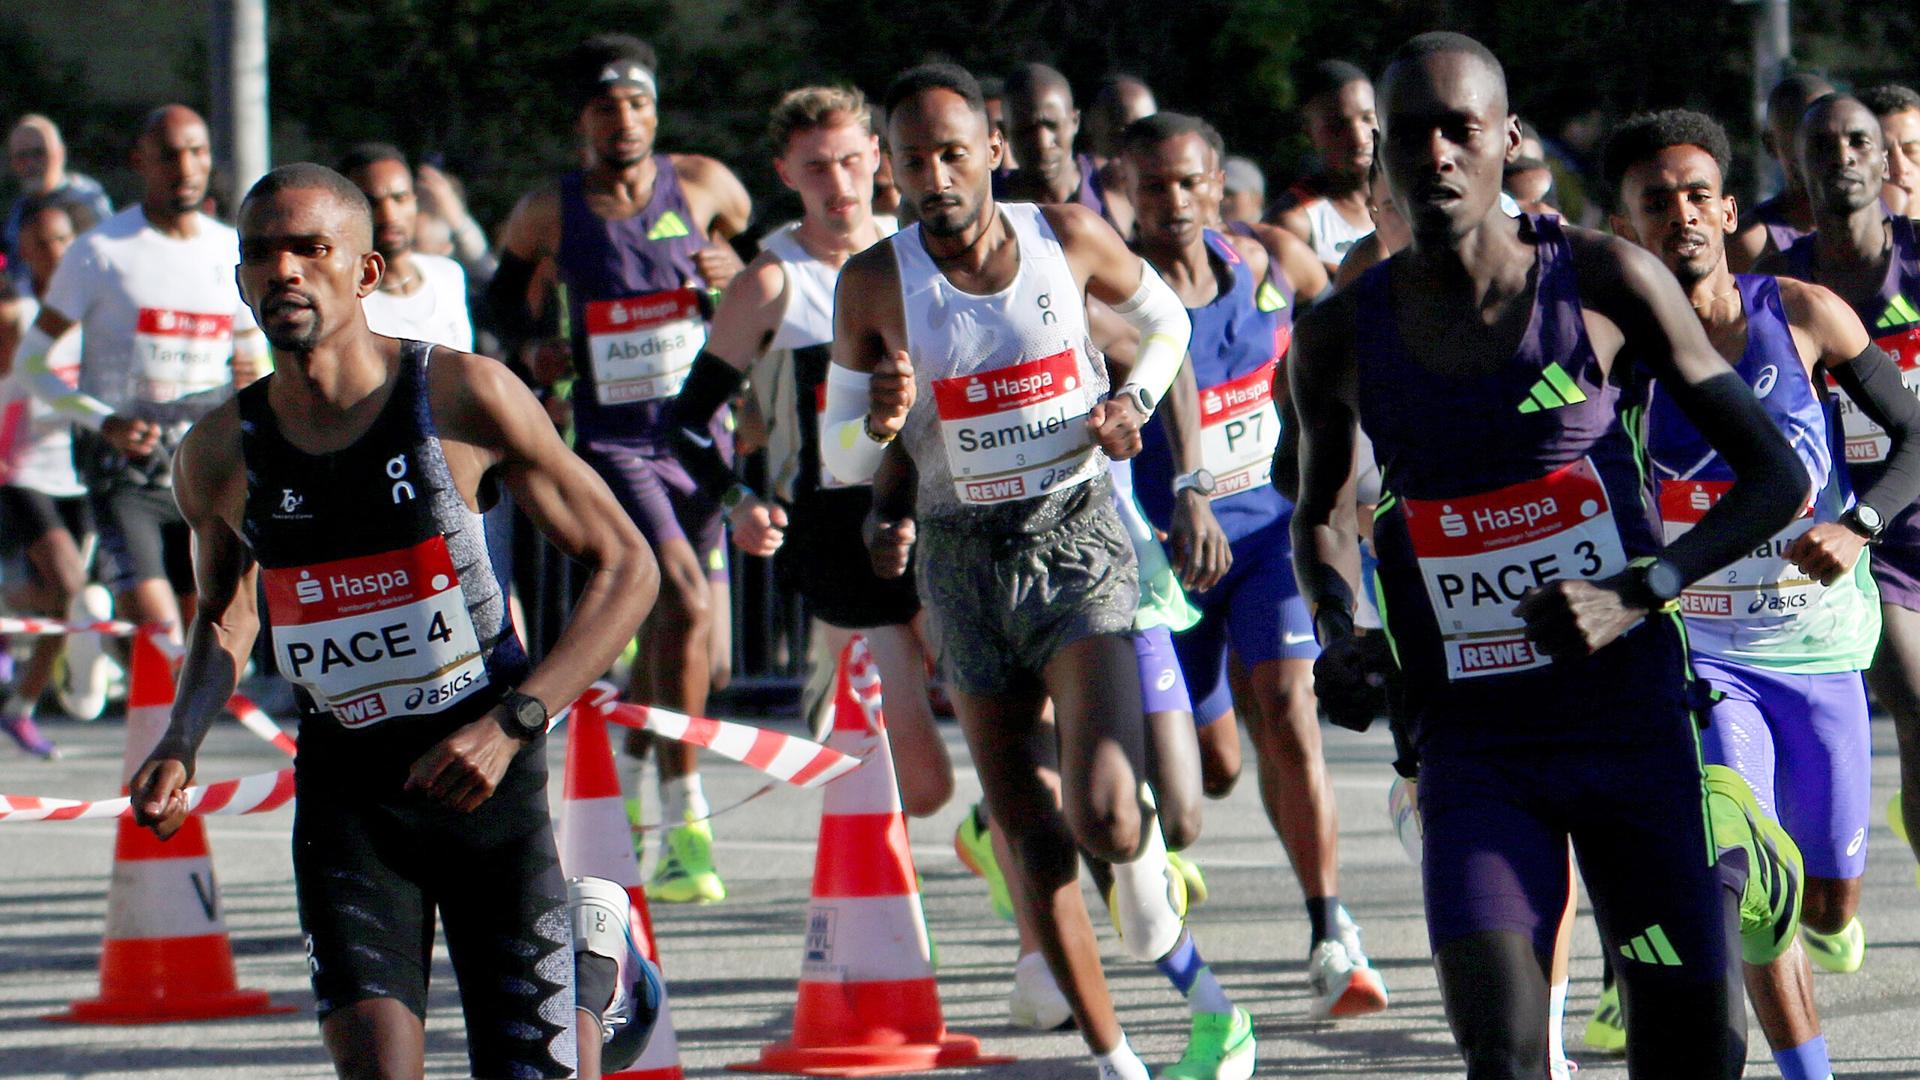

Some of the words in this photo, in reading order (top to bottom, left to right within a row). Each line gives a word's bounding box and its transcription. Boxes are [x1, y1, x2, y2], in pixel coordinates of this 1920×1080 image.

[632, 300, 678, 320] Haspa
[608, 334, 686, 361] Abdisa
[993, 371, 1053, 397] Haspa
[1225, 380, 1269, 407] Haspa
[958, 407, 1068, 452] Samuel
[1225, 411, 1264, 452] P7
[1016, 453, 1026, 466] 3
[386, 454, 416, 504] on
[969, 479, 1022, 500] REWE
[1216, 473, 1249, 493] EWE
[1473, 497, 1558, 532] Haspa
[329, 569, 409, 598] Haspa
[1437, 553, 1560, 609] PACE
[1574, 540, 1602, 576] 3
[1728, 571, 1737, 584] 2
[1768, 594, 1807, 611] asics
[287, 622, 416, 678] PACE
[427, 611, 453, 643] 4
[1463, 643, 1530, 668] REWE
[428, 670, 472, 705] asics
[189, 872, 217, 922] V
